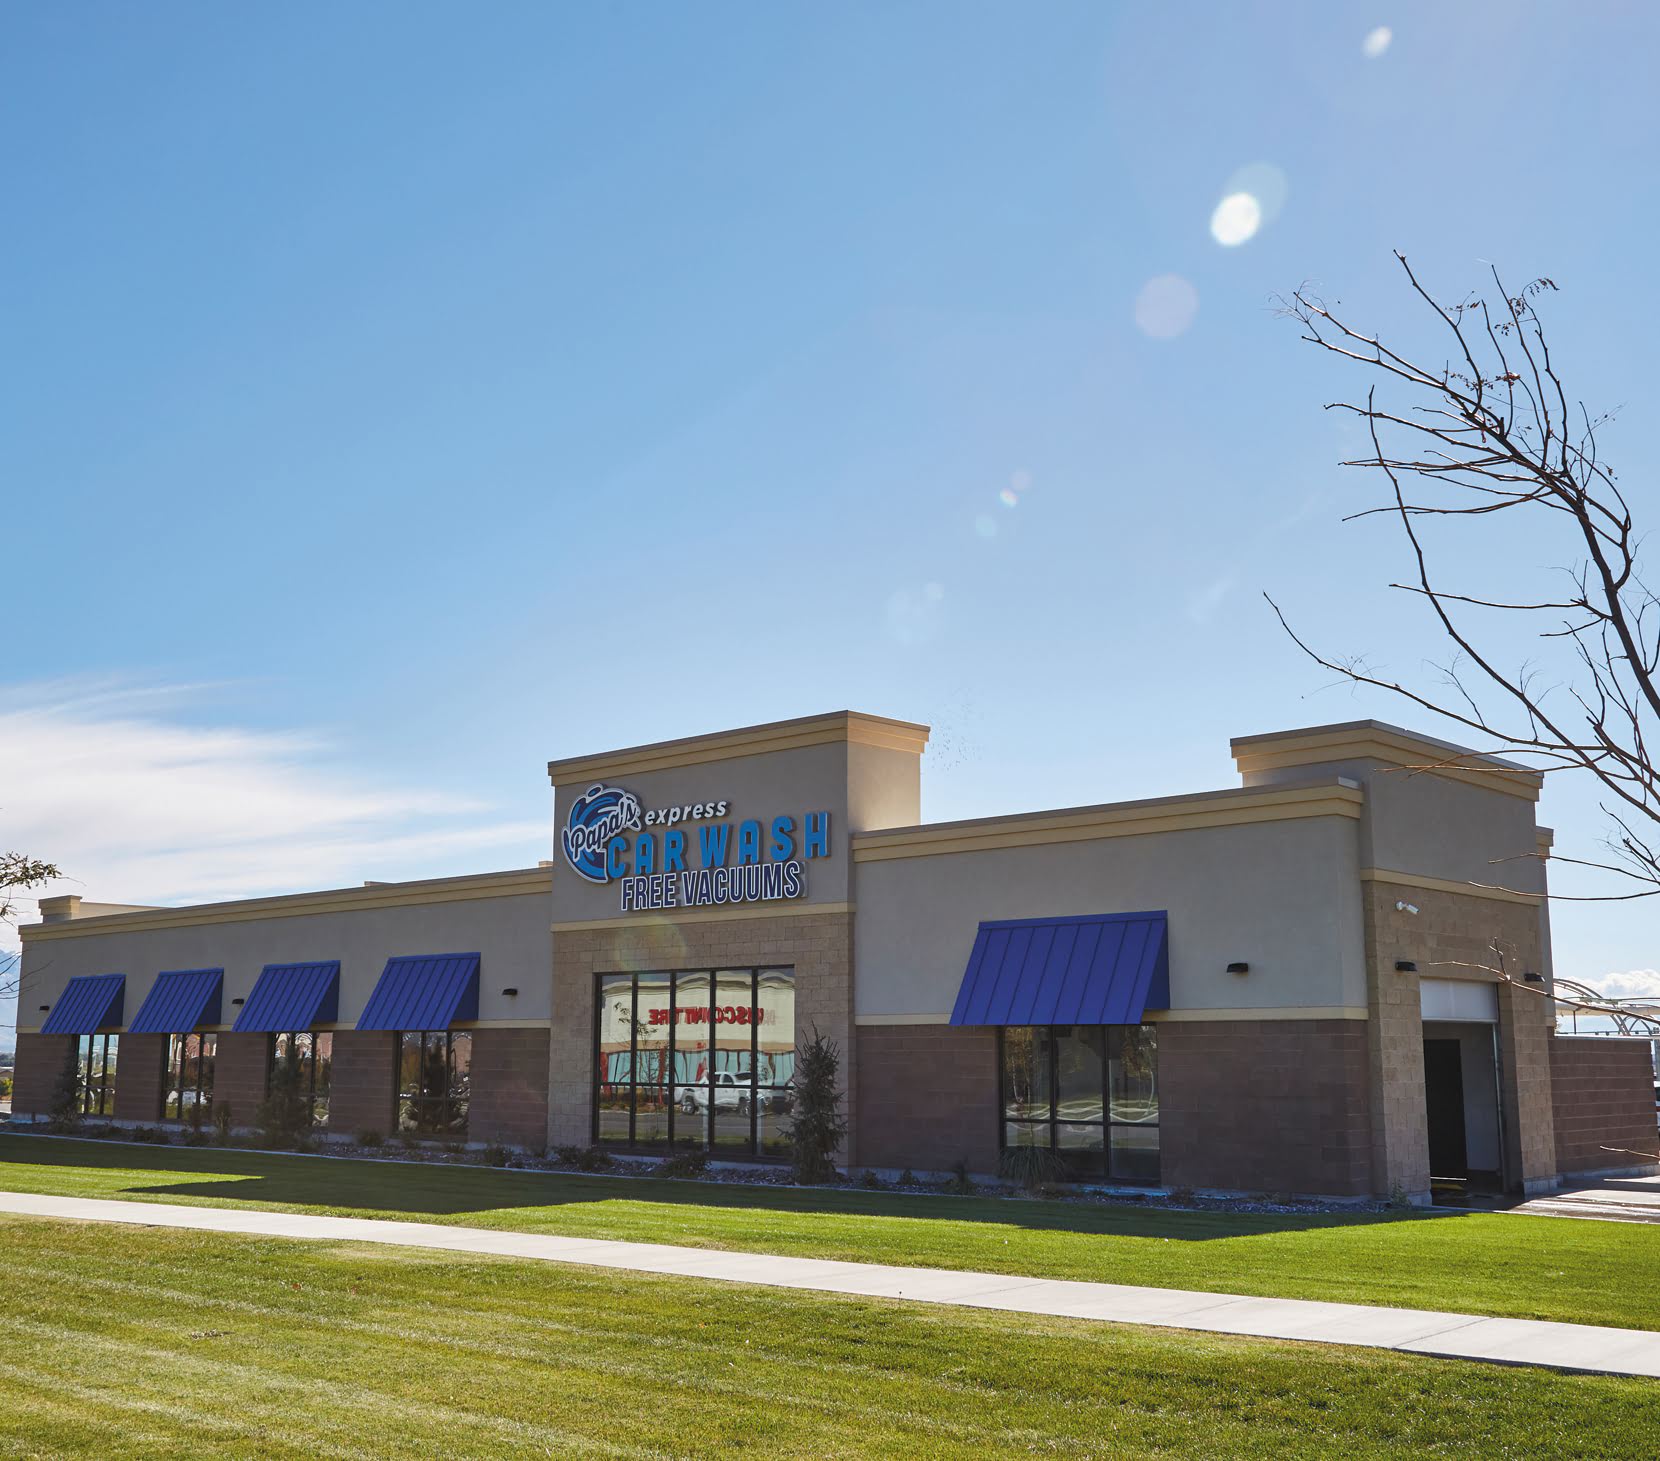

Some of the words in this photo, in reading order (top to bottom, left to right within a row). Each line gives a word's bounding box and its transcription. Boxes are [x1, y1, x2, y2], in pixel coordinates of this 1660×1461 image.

[569, 794, 641, 862] Papa's
[644, 800, 727, 826] express
[607, 830, 684, 879] CAR
[698, 811, 828, 868] WASH
[621, 872, 677, 911] FREE
[682, 861, 801, 906] VACUUMS
